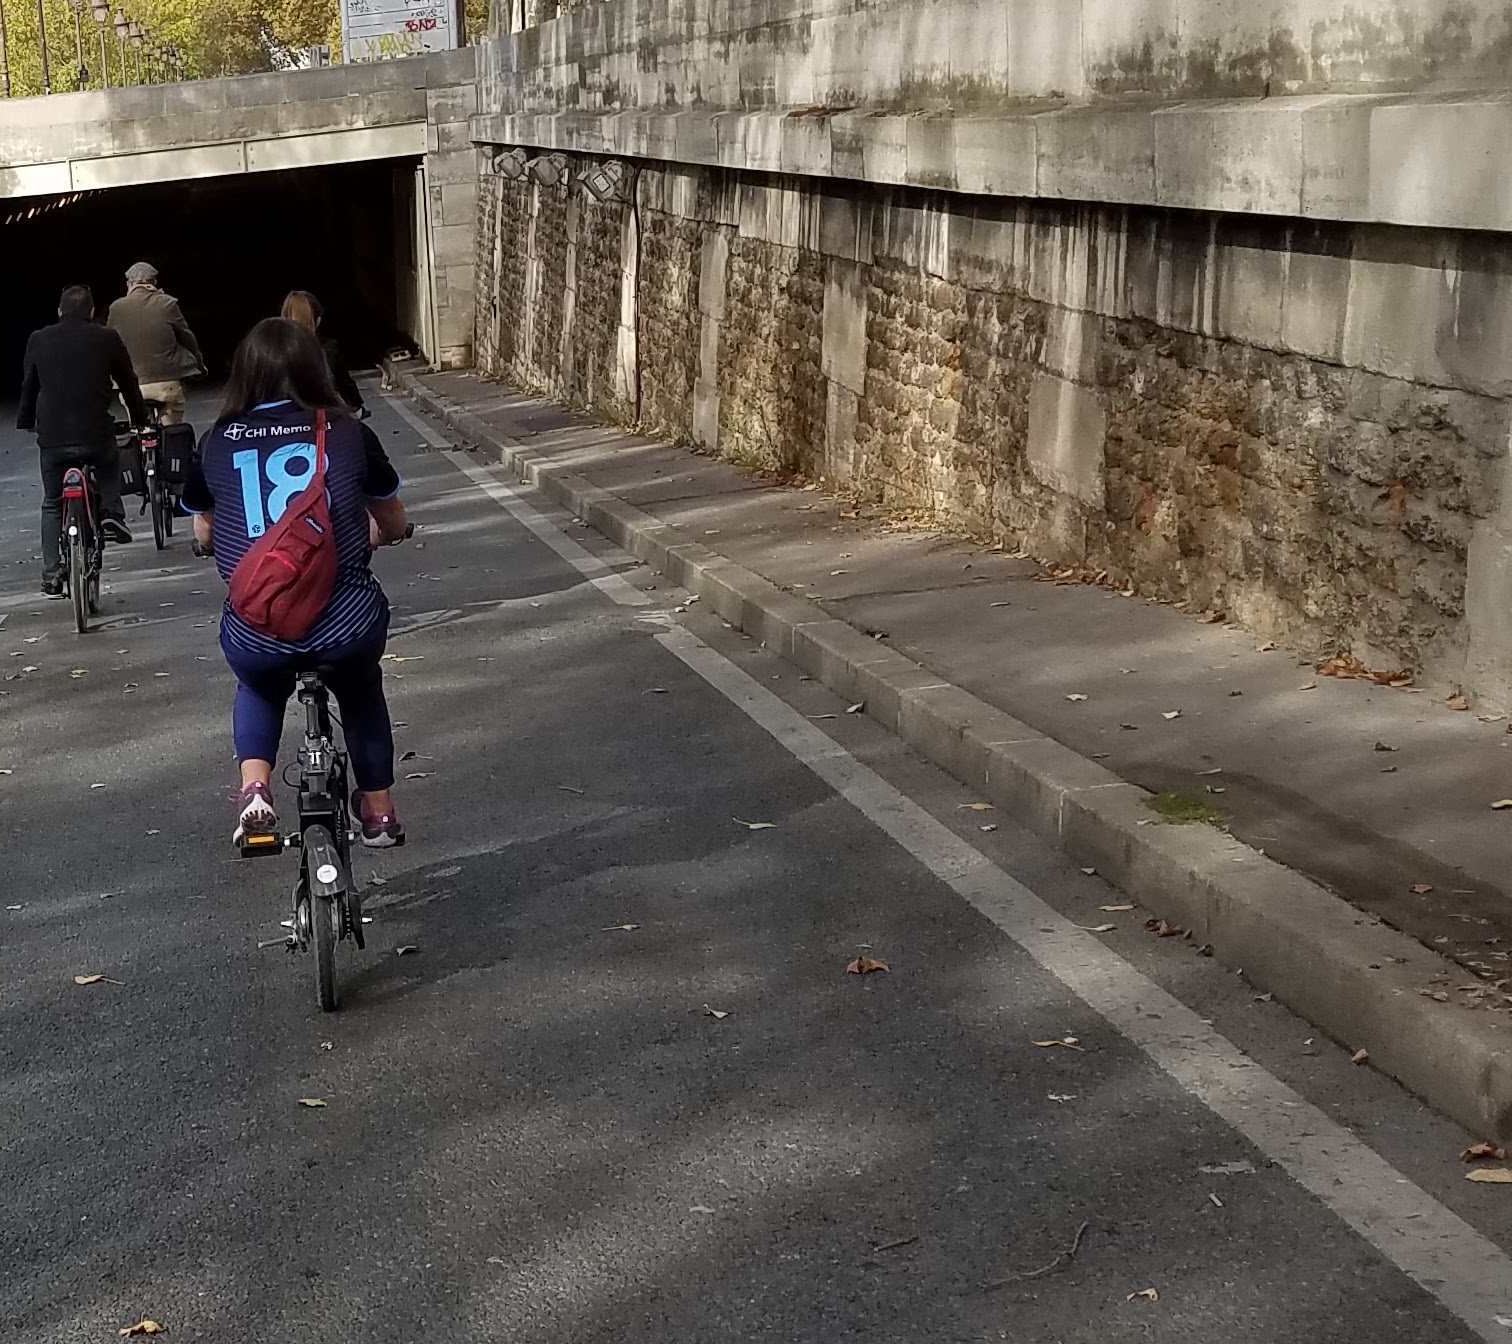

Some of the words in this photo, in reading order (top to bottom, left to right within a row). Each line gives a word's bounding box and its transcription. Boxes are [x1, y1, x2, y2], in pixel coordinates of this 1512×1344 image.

[245, 427, 267, 438] CHI
[270, 421, 332, 436] Memol
[232, 442, 332, 538] 18
